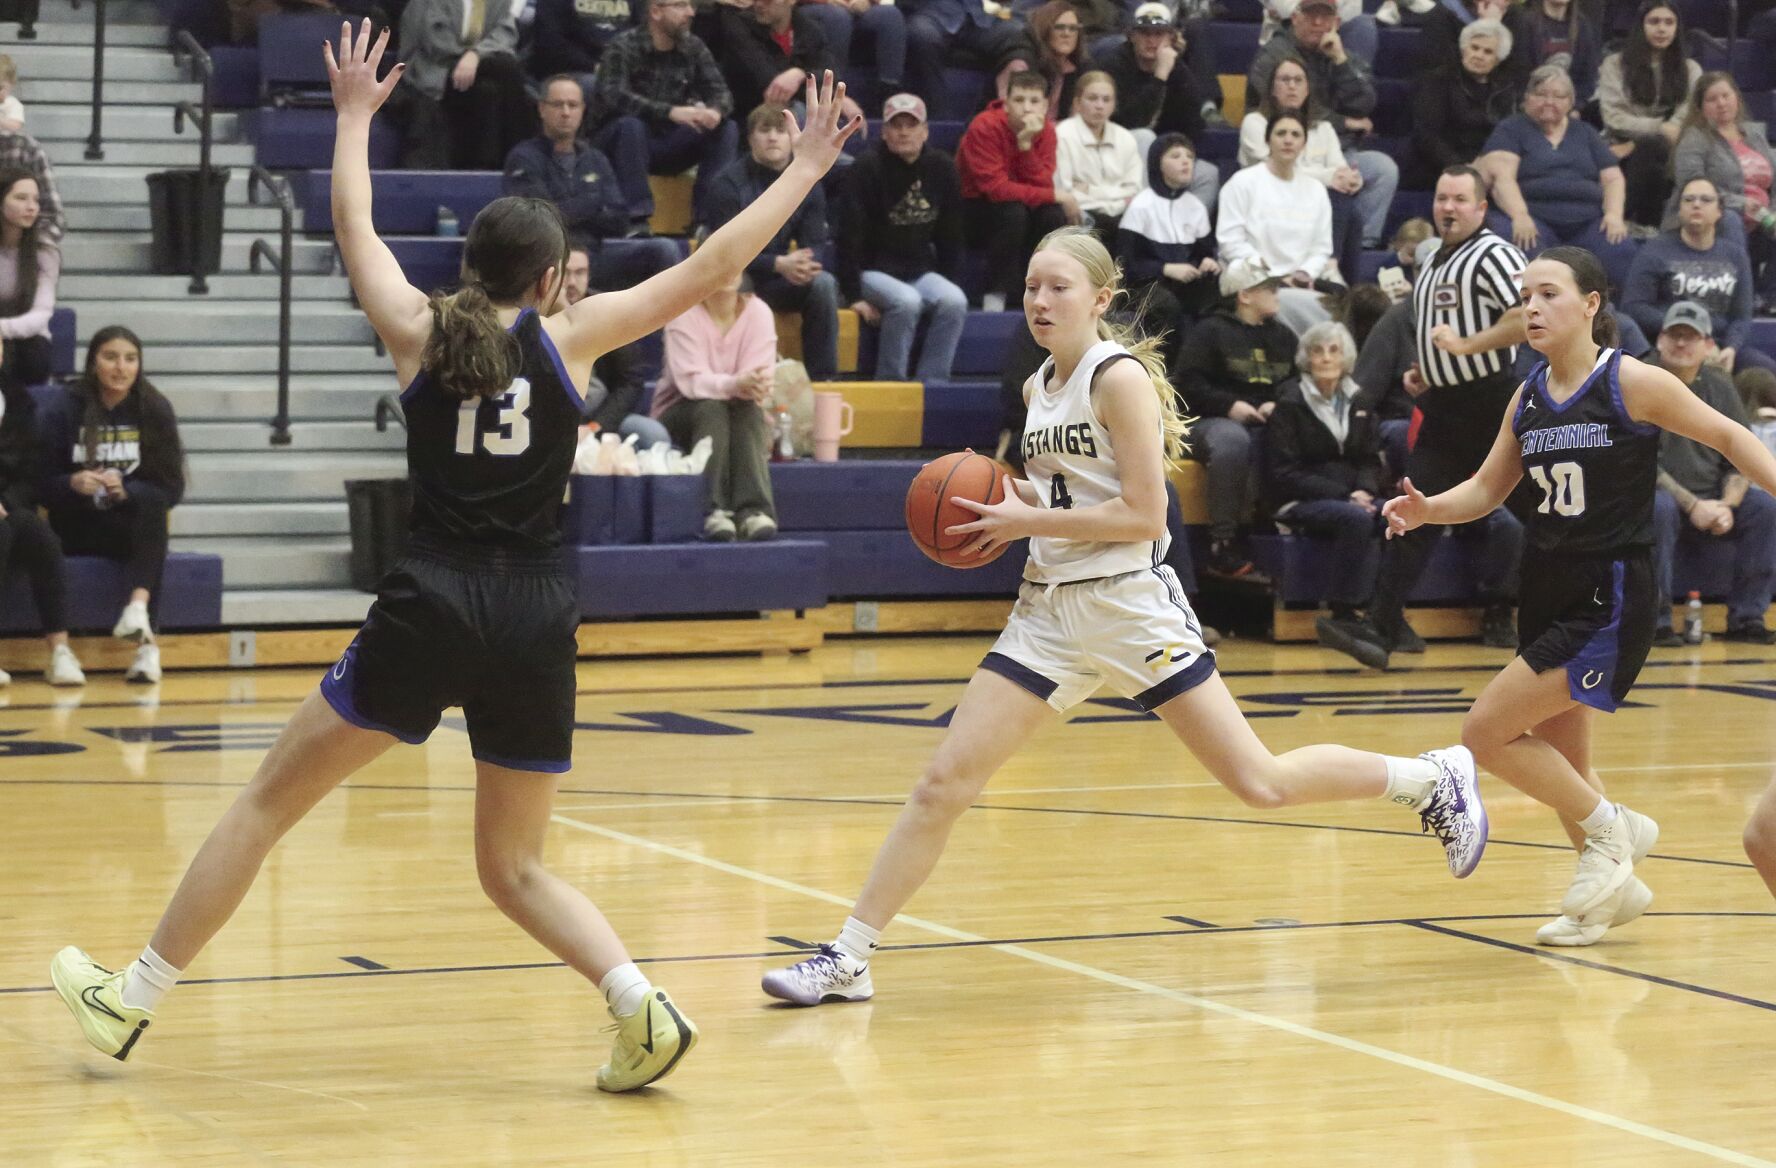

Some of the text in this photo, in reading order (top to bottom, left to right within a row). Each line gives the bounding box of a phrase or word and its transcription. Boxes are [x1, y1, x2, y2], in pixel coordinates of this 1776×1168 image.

[455, 377, 531, 455] 13
[1049, 472, 1073, 510] 4
[1528, 461, 1586, 517] 10
